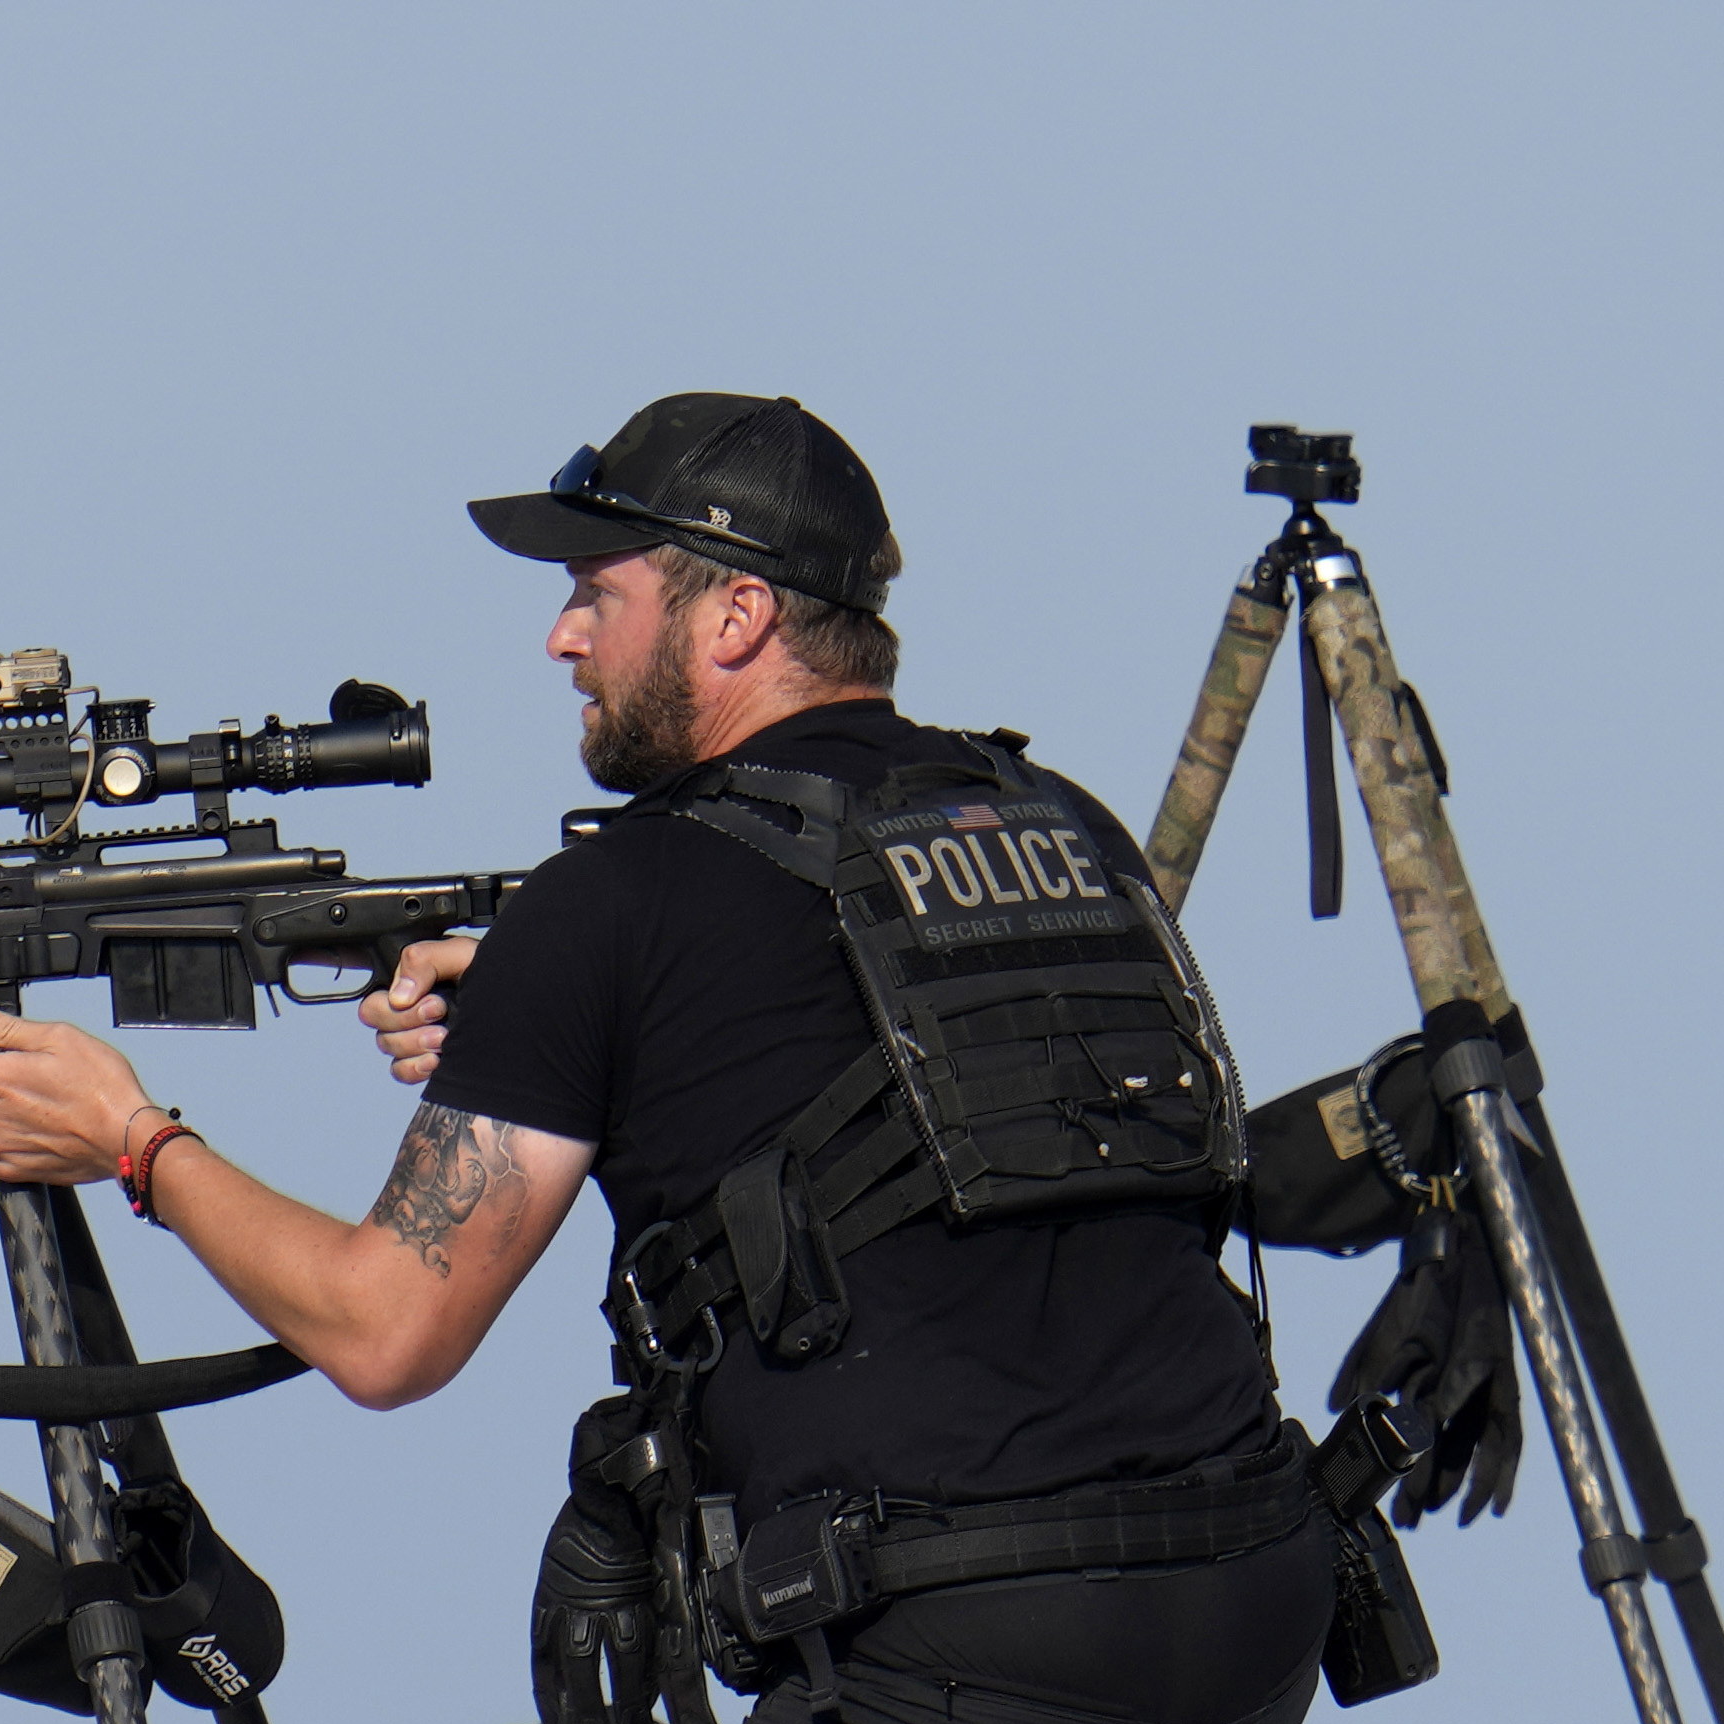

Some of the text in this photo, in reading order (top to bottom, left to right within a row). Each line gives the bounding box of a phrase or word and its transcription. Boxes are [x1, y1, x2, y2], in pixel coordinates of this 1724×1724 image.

[868, 803, 1067, 838] UNITED STATES
[884, 828, 1107, 916] POLICE
[925, 909, 1120, 945] SECRET SERVICE
[761, 1578, 813, 1609] MAXPEDITION
[200, 1649, 250, 1696] RRS
